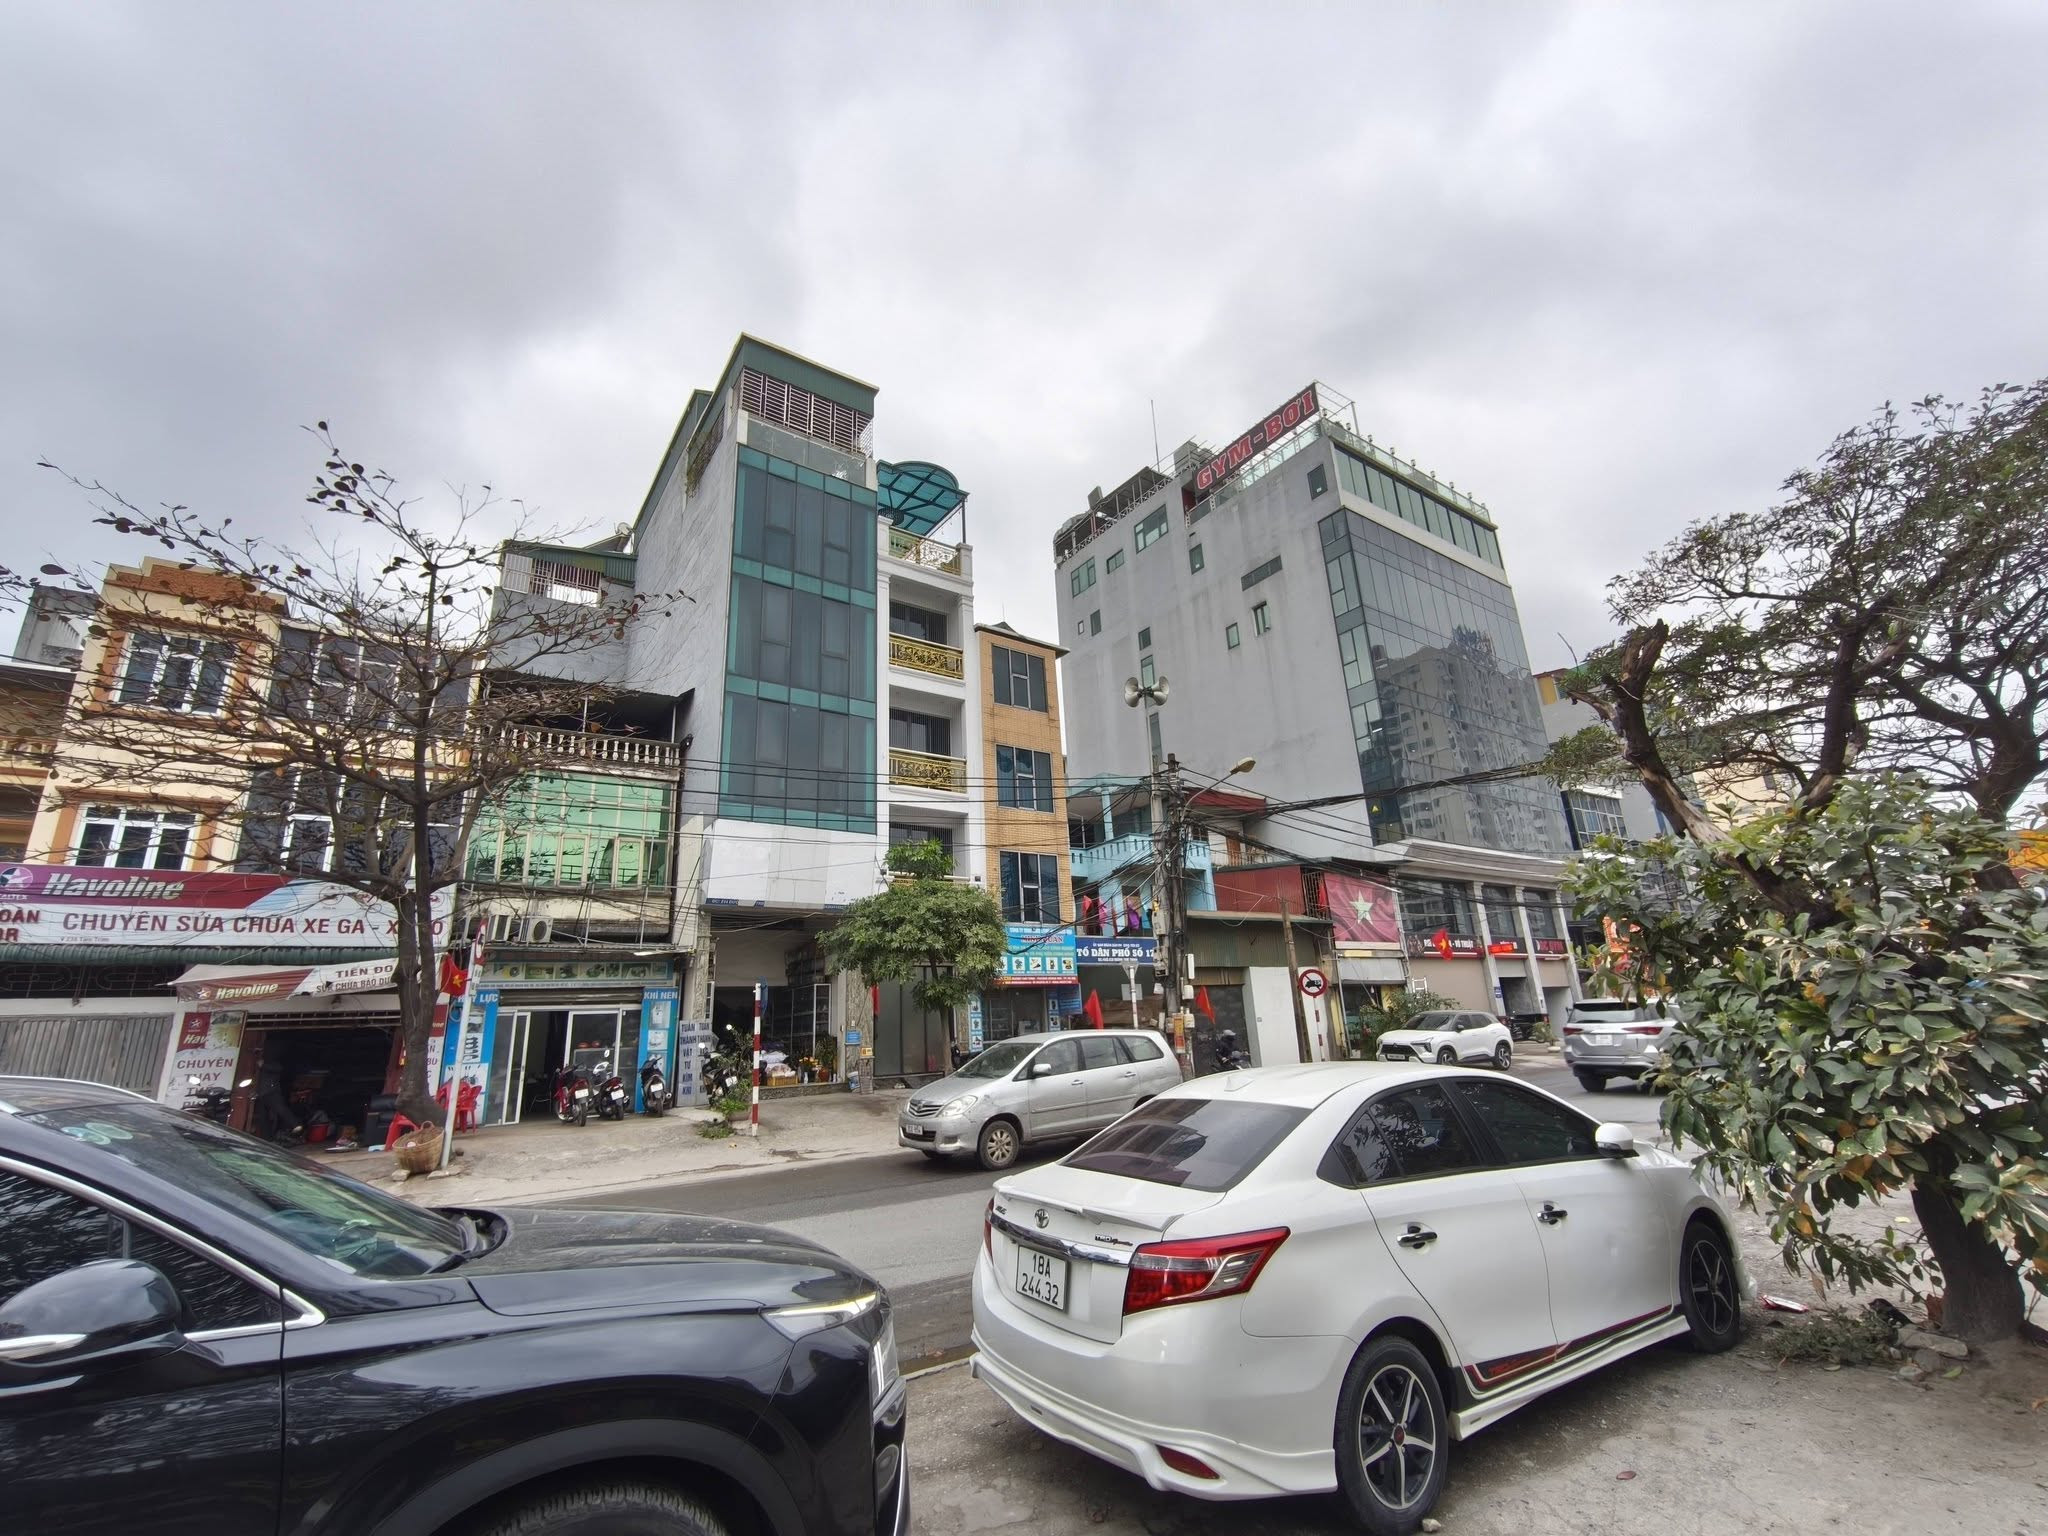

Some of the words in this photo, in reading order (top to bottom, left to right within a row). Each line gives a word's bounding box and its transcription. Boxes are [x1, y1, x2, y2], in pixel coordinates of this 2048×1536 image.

[41, 873, 185, 900] Havoline
[63, 910, 167, 932] CHUYÊN
[176, 911, 224, 932] SỬA
[302, 918, 330, 933] XE
[337, 919, 365, 934] GA
[385, 919, 399, 934] X
[1091, 946, 1110, 957] DÂN
[1132, 946, 1144, 957] SỐ
[216, 983, 279, 999] Havoline
[177, 1057, 234, 1069] CHUYÊN
[1032, 1253, 1051, 1279] 18A
[1021, 1273, 1059, 1306] 244.32
